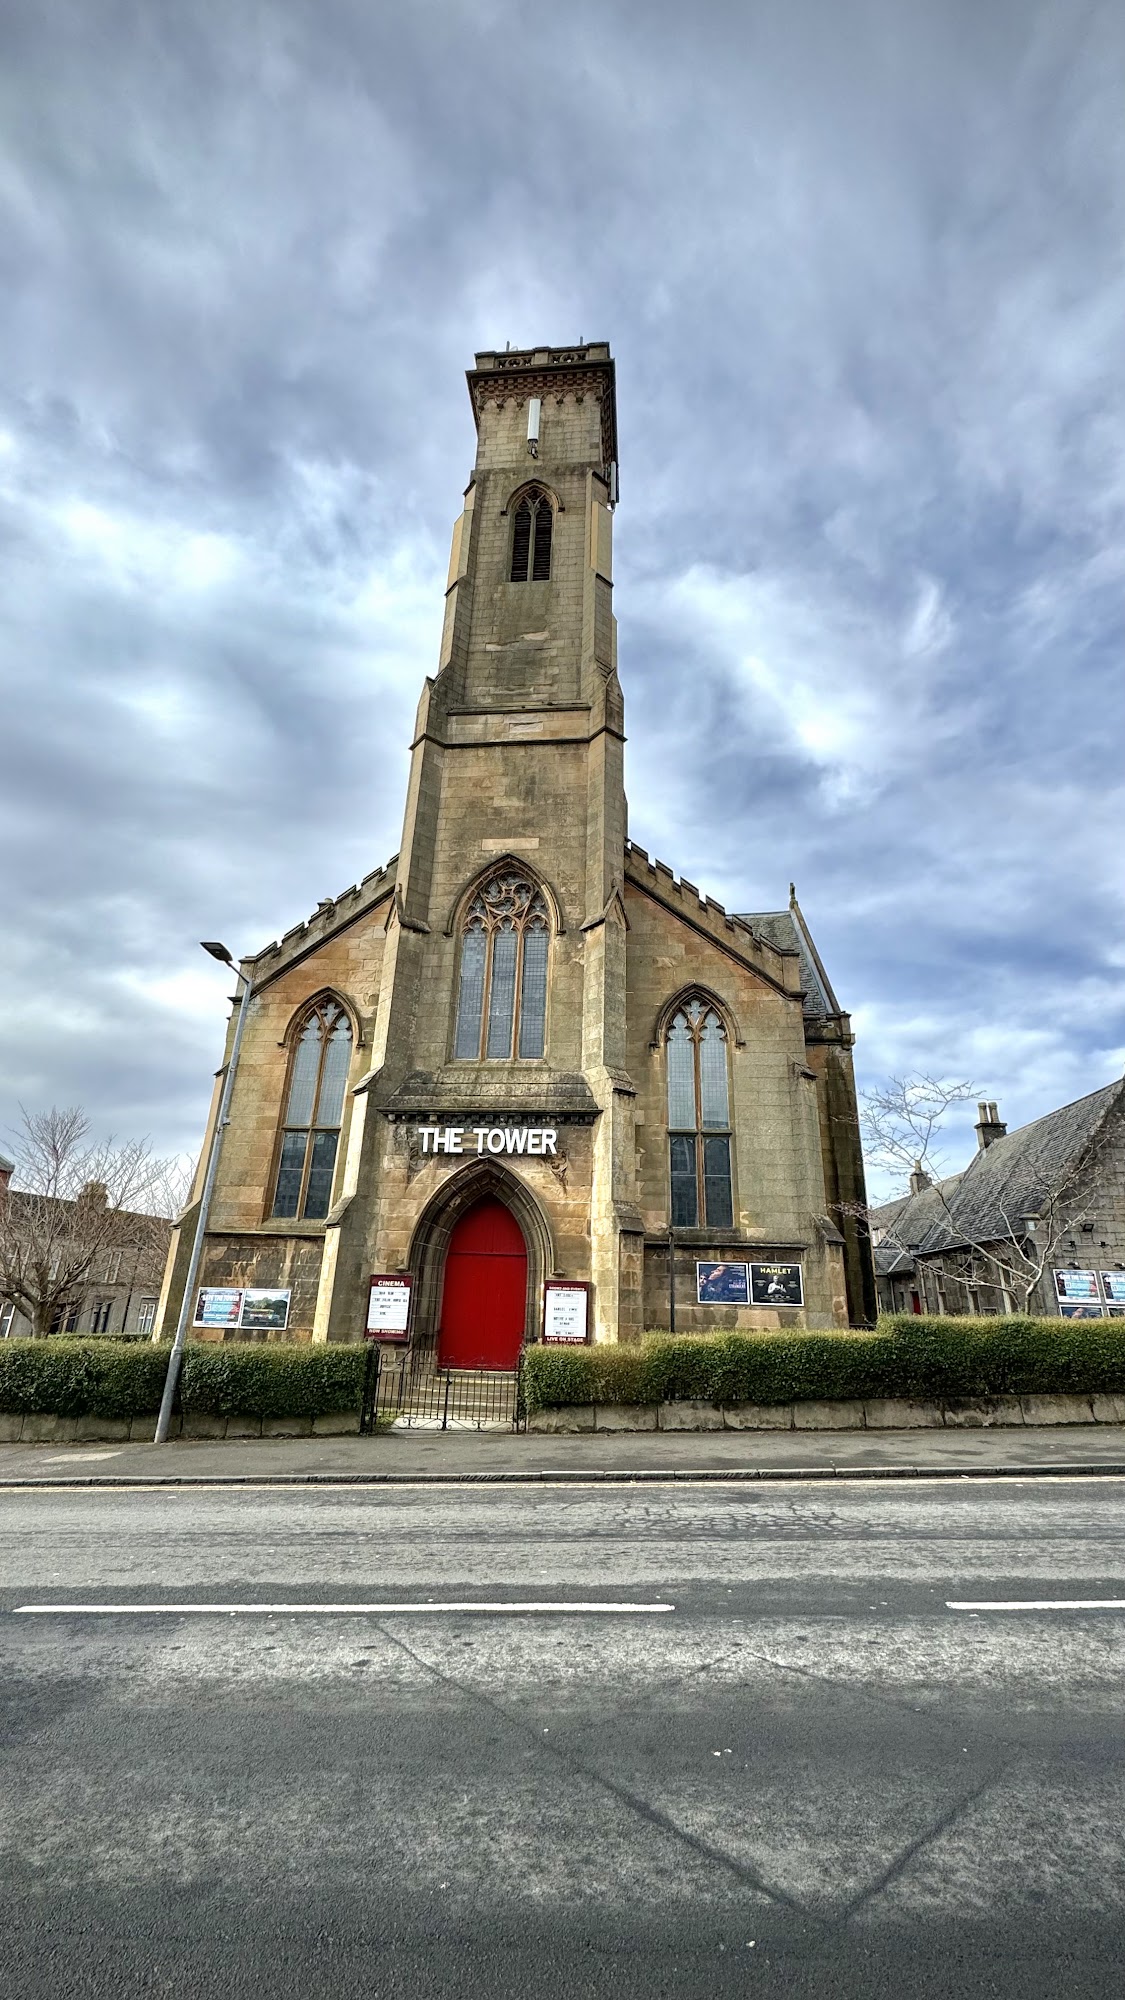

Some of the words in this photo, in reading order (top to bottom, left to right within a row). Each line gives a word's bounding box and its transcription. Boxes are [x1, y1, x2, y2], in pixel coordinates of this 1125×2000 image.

[419, 1127, 464, 1153] THE
[473, 1128, 557, 1155] TOWER
[760, 1267, 792, 1275] HAMLET
